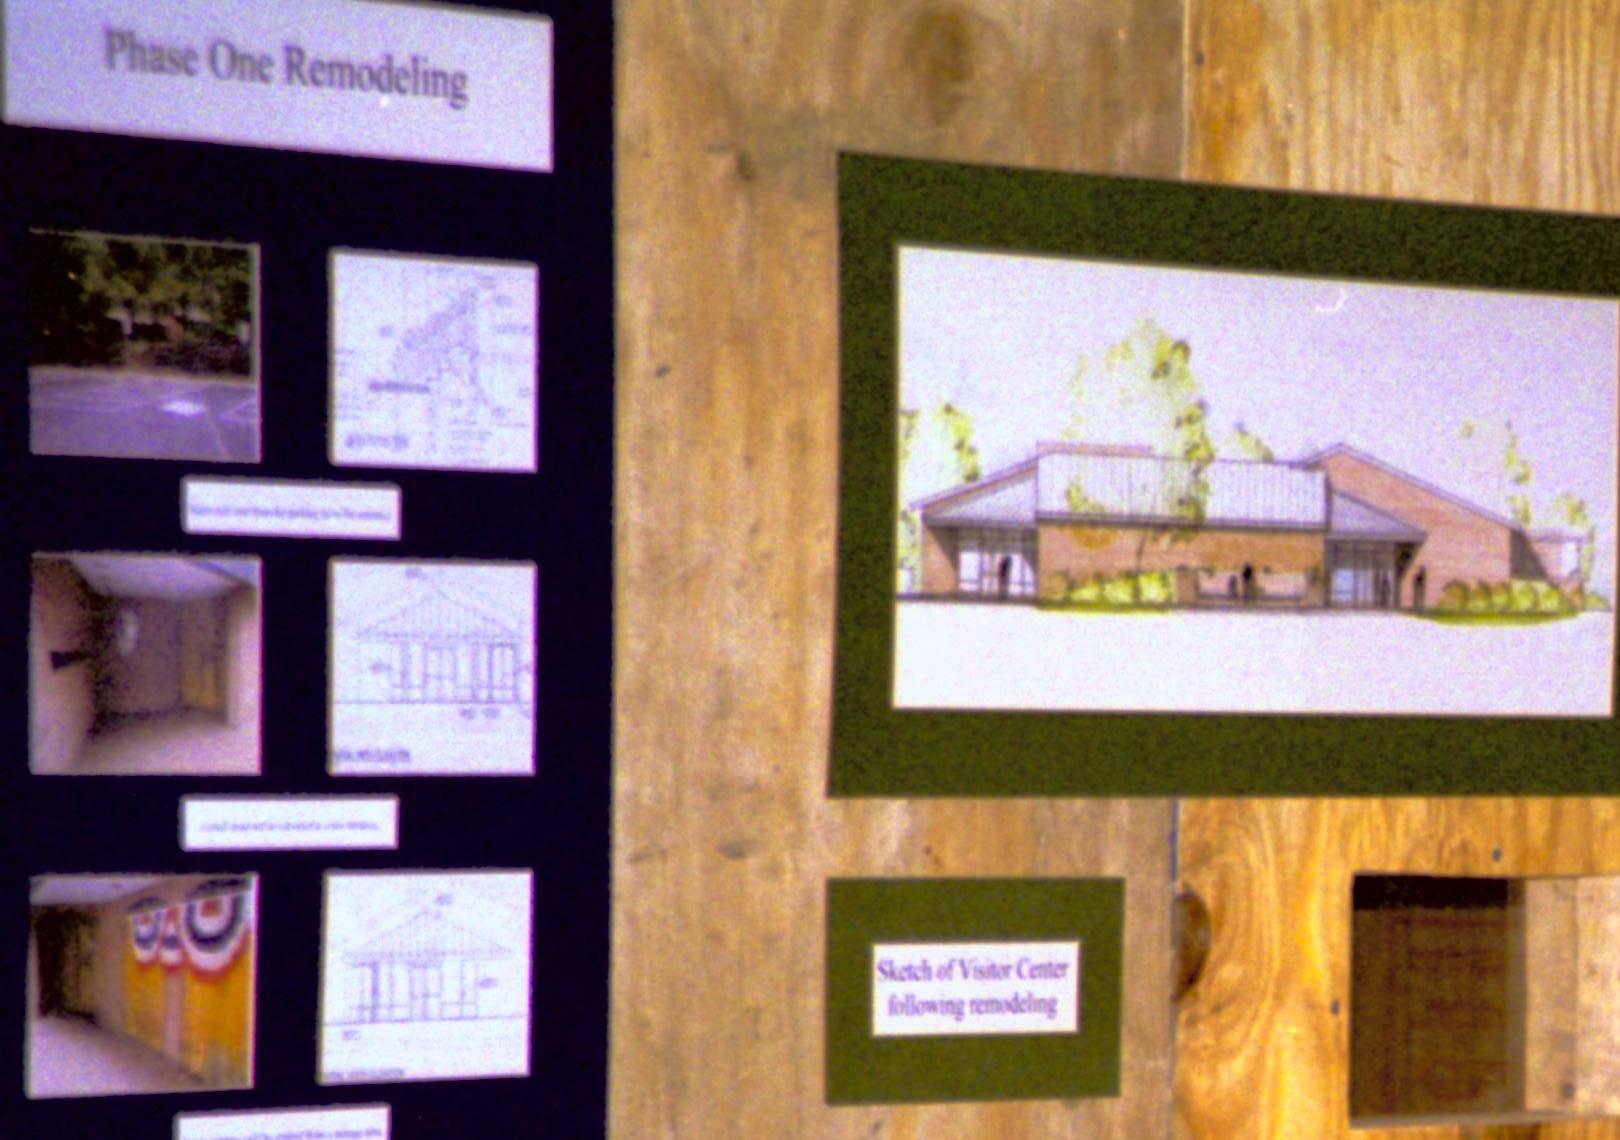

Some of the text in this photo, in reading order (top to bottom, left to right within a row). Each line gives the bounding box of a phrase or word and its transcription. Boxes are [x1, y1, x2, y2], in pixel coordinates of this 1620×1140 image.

[104, 29, 470, 111] Phase One Remodeling
[876, 956, 1070, 982] Sketch of Visitor Center
[887, 991, 1059, 1022] following remodeling
